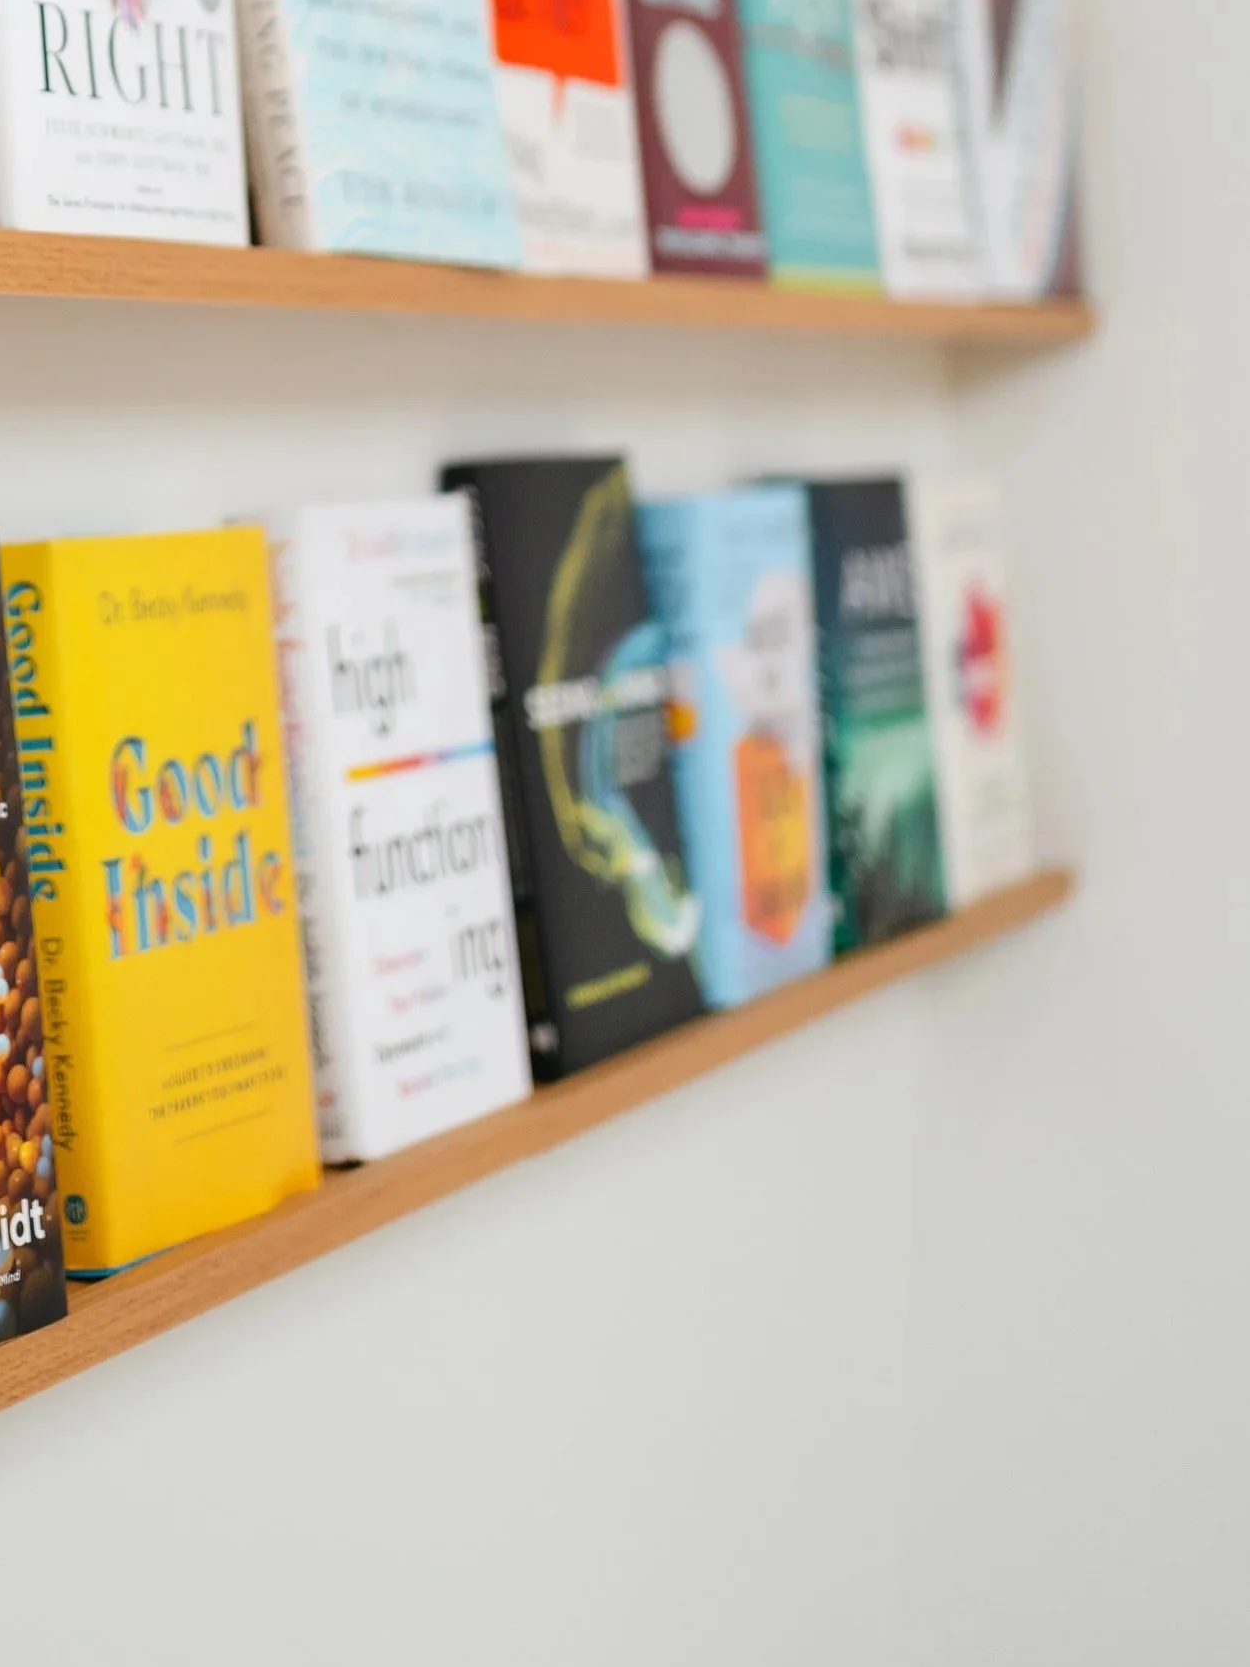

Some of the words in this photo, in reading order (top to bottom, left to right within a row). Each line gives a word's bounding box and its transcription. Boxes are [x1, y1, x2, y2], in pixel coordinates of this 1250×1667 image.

[33, 0, 227, 118] RIGHT
[6, 581, 52, 718] Good
[16, 737, 69, 906] Inside
[111, 717, 266, 834] Good
[101, 828, 285, 960] Inside
[43, 978, 68, 1046] Becky
[51, 1053, 77, 1152] Kennedy
[0, 1270, 22, 1287] Mind
